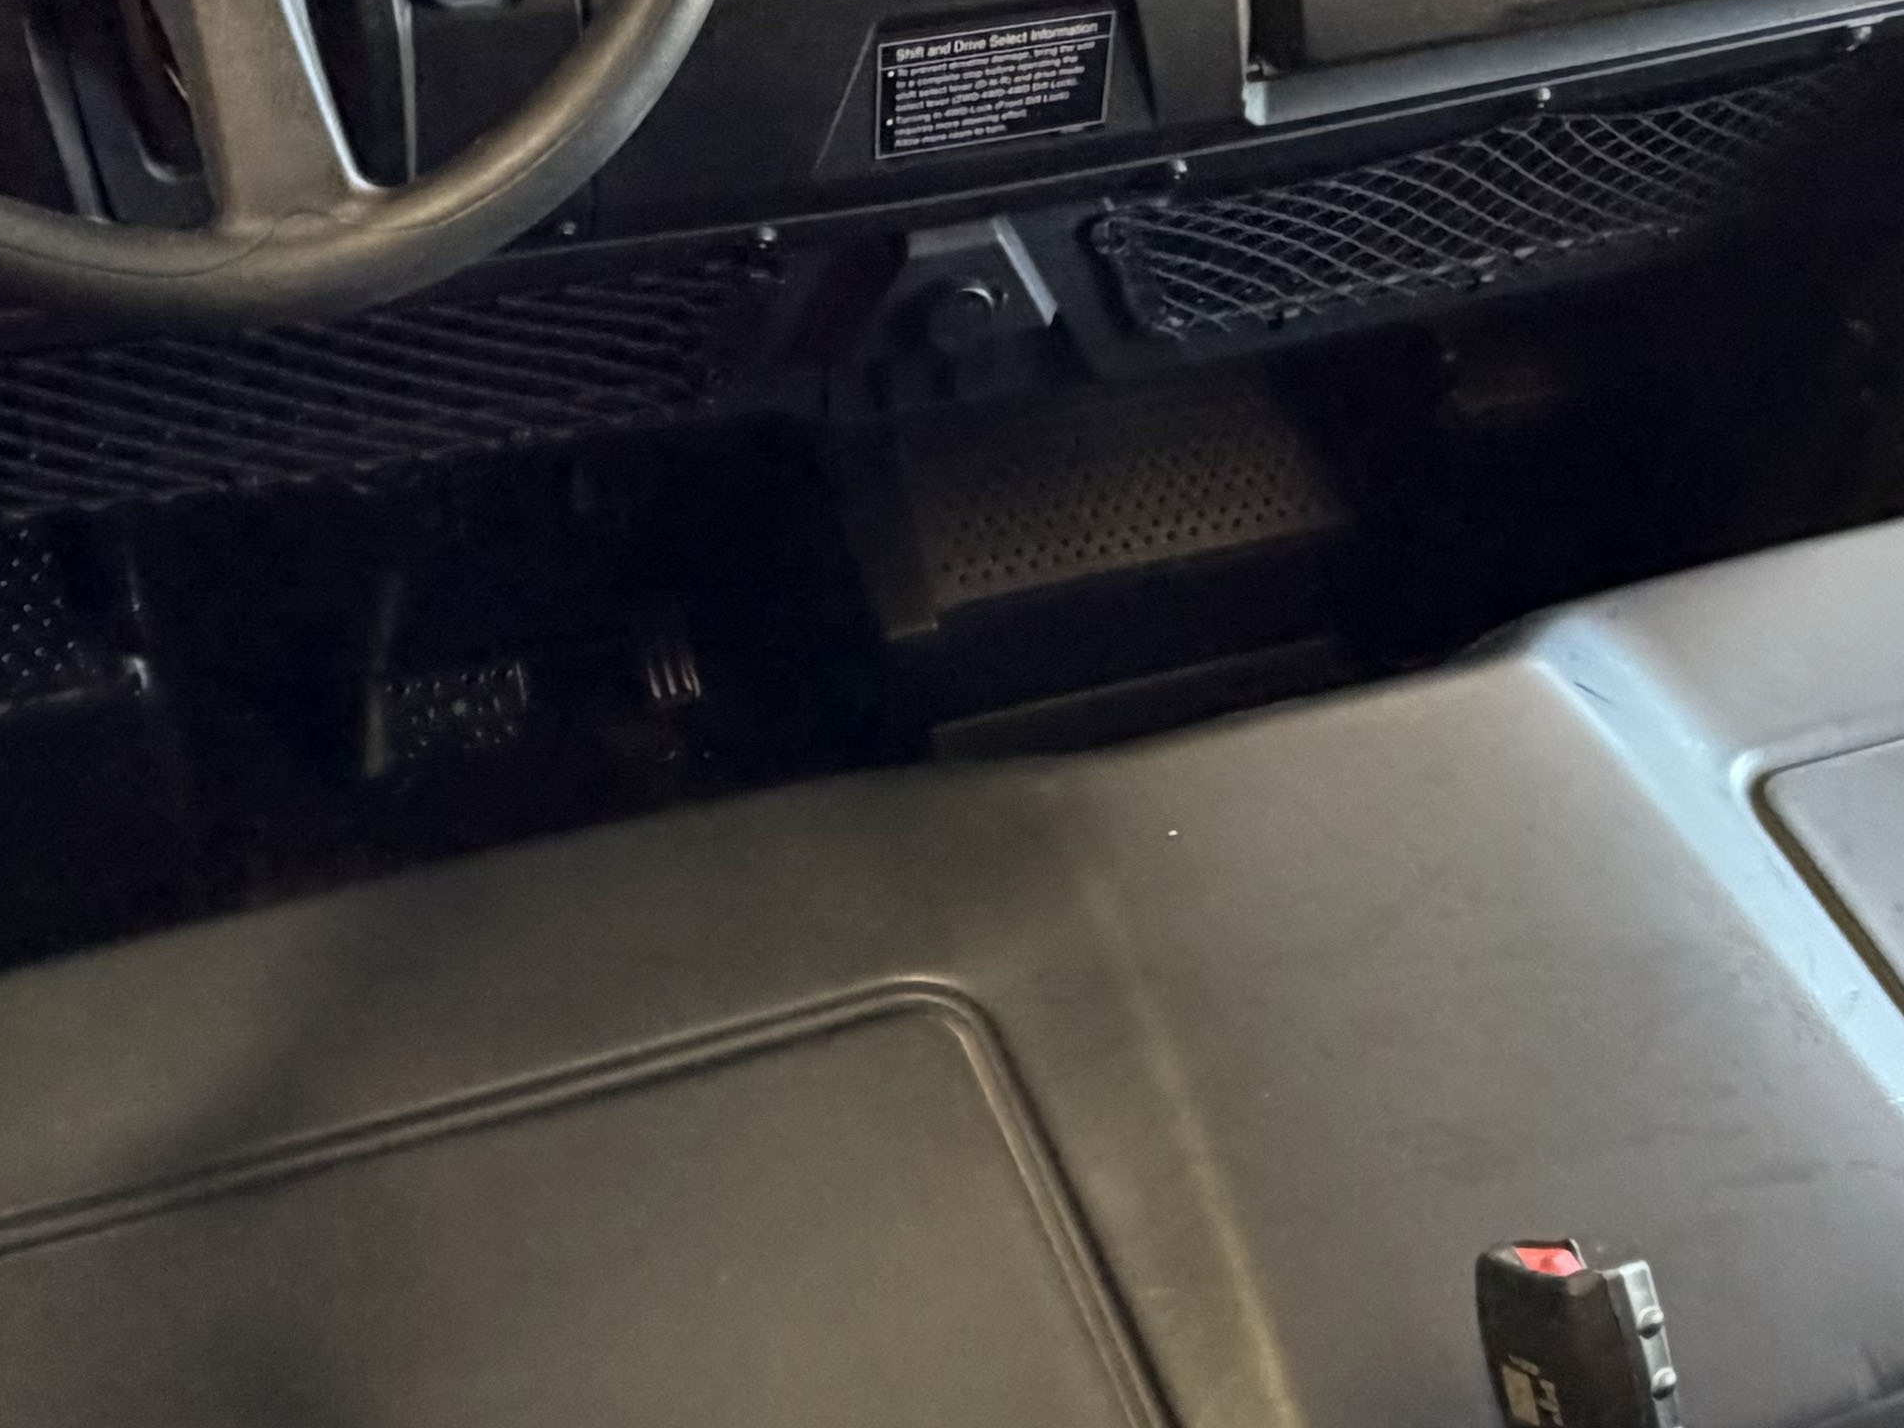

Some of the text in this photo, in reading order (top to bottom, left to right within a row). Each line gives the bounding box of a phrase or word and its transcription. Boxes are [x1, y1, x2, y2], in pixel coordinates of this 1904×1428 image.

[896, 23, 1098, 62] Shift and Drive Select Information
